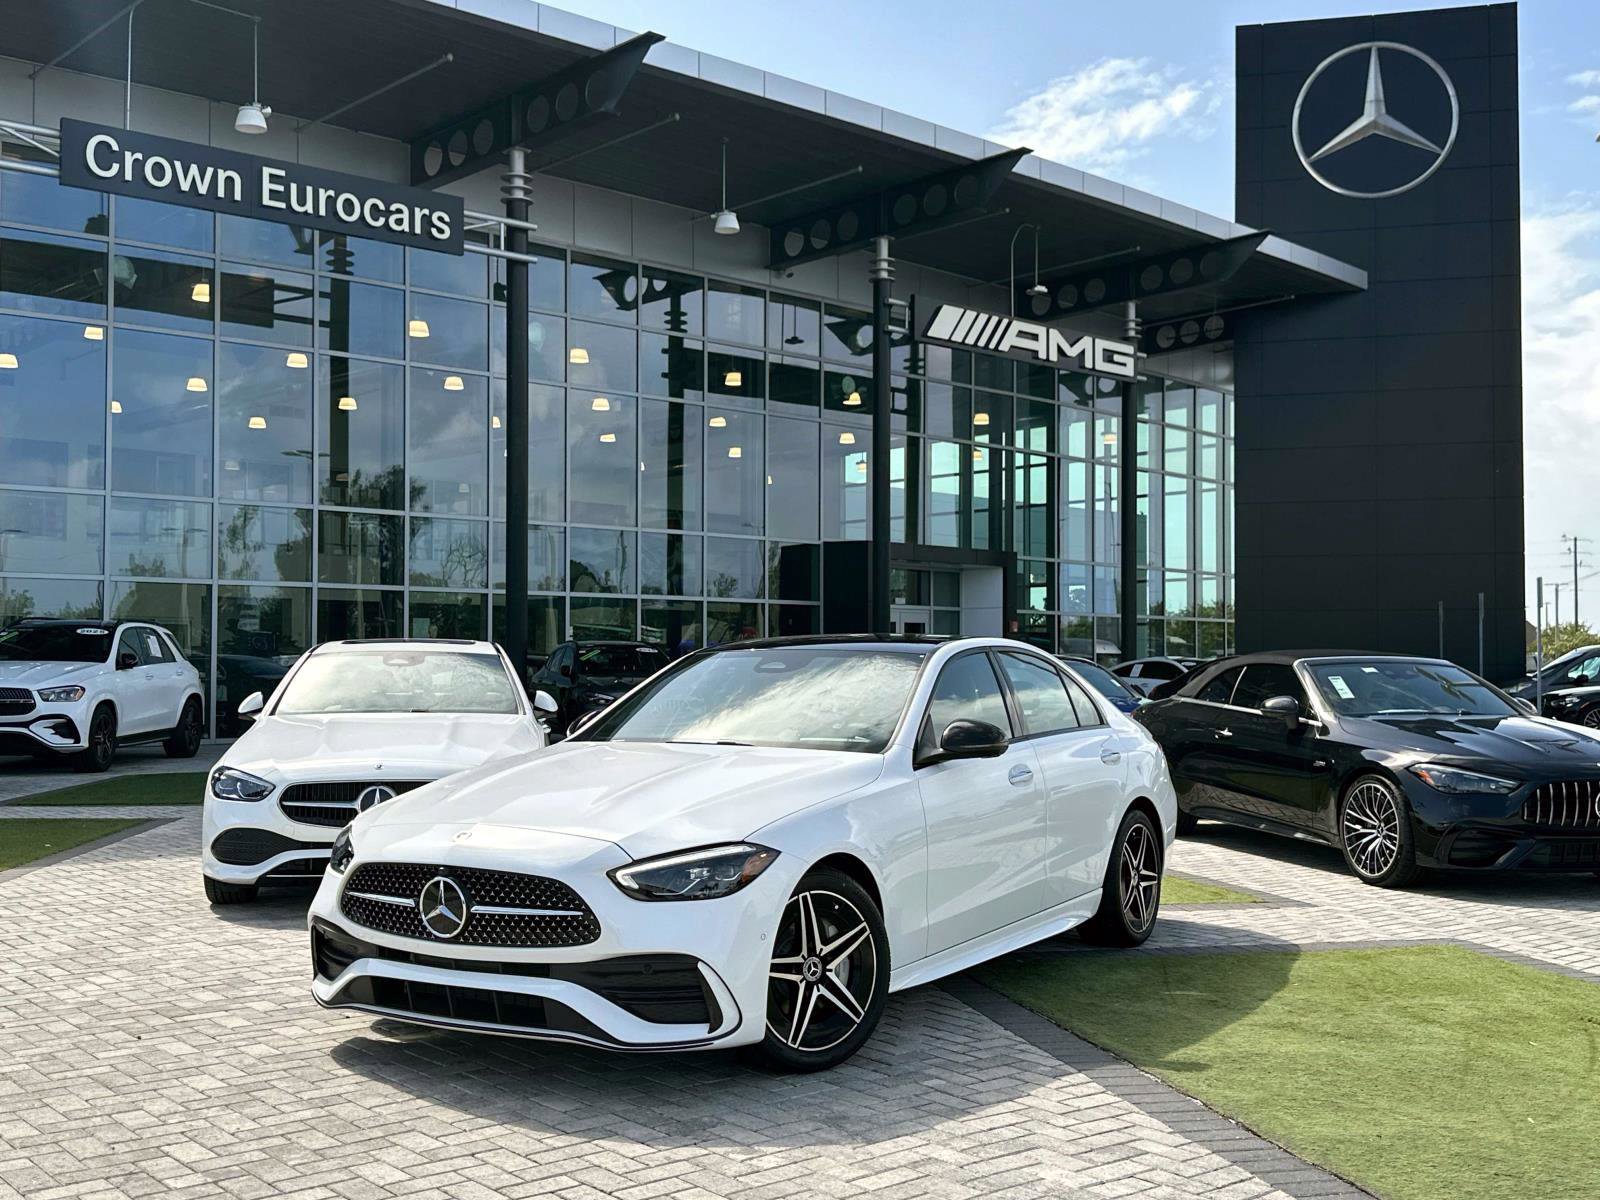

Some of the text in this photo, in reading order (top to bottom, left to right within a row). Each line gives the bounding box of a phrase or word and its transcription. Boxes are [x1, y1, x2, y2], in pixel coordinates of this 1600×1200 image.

[85, 134, 452, 241] Crown Eurocars
[998, 320, 1135, 377] AMG
